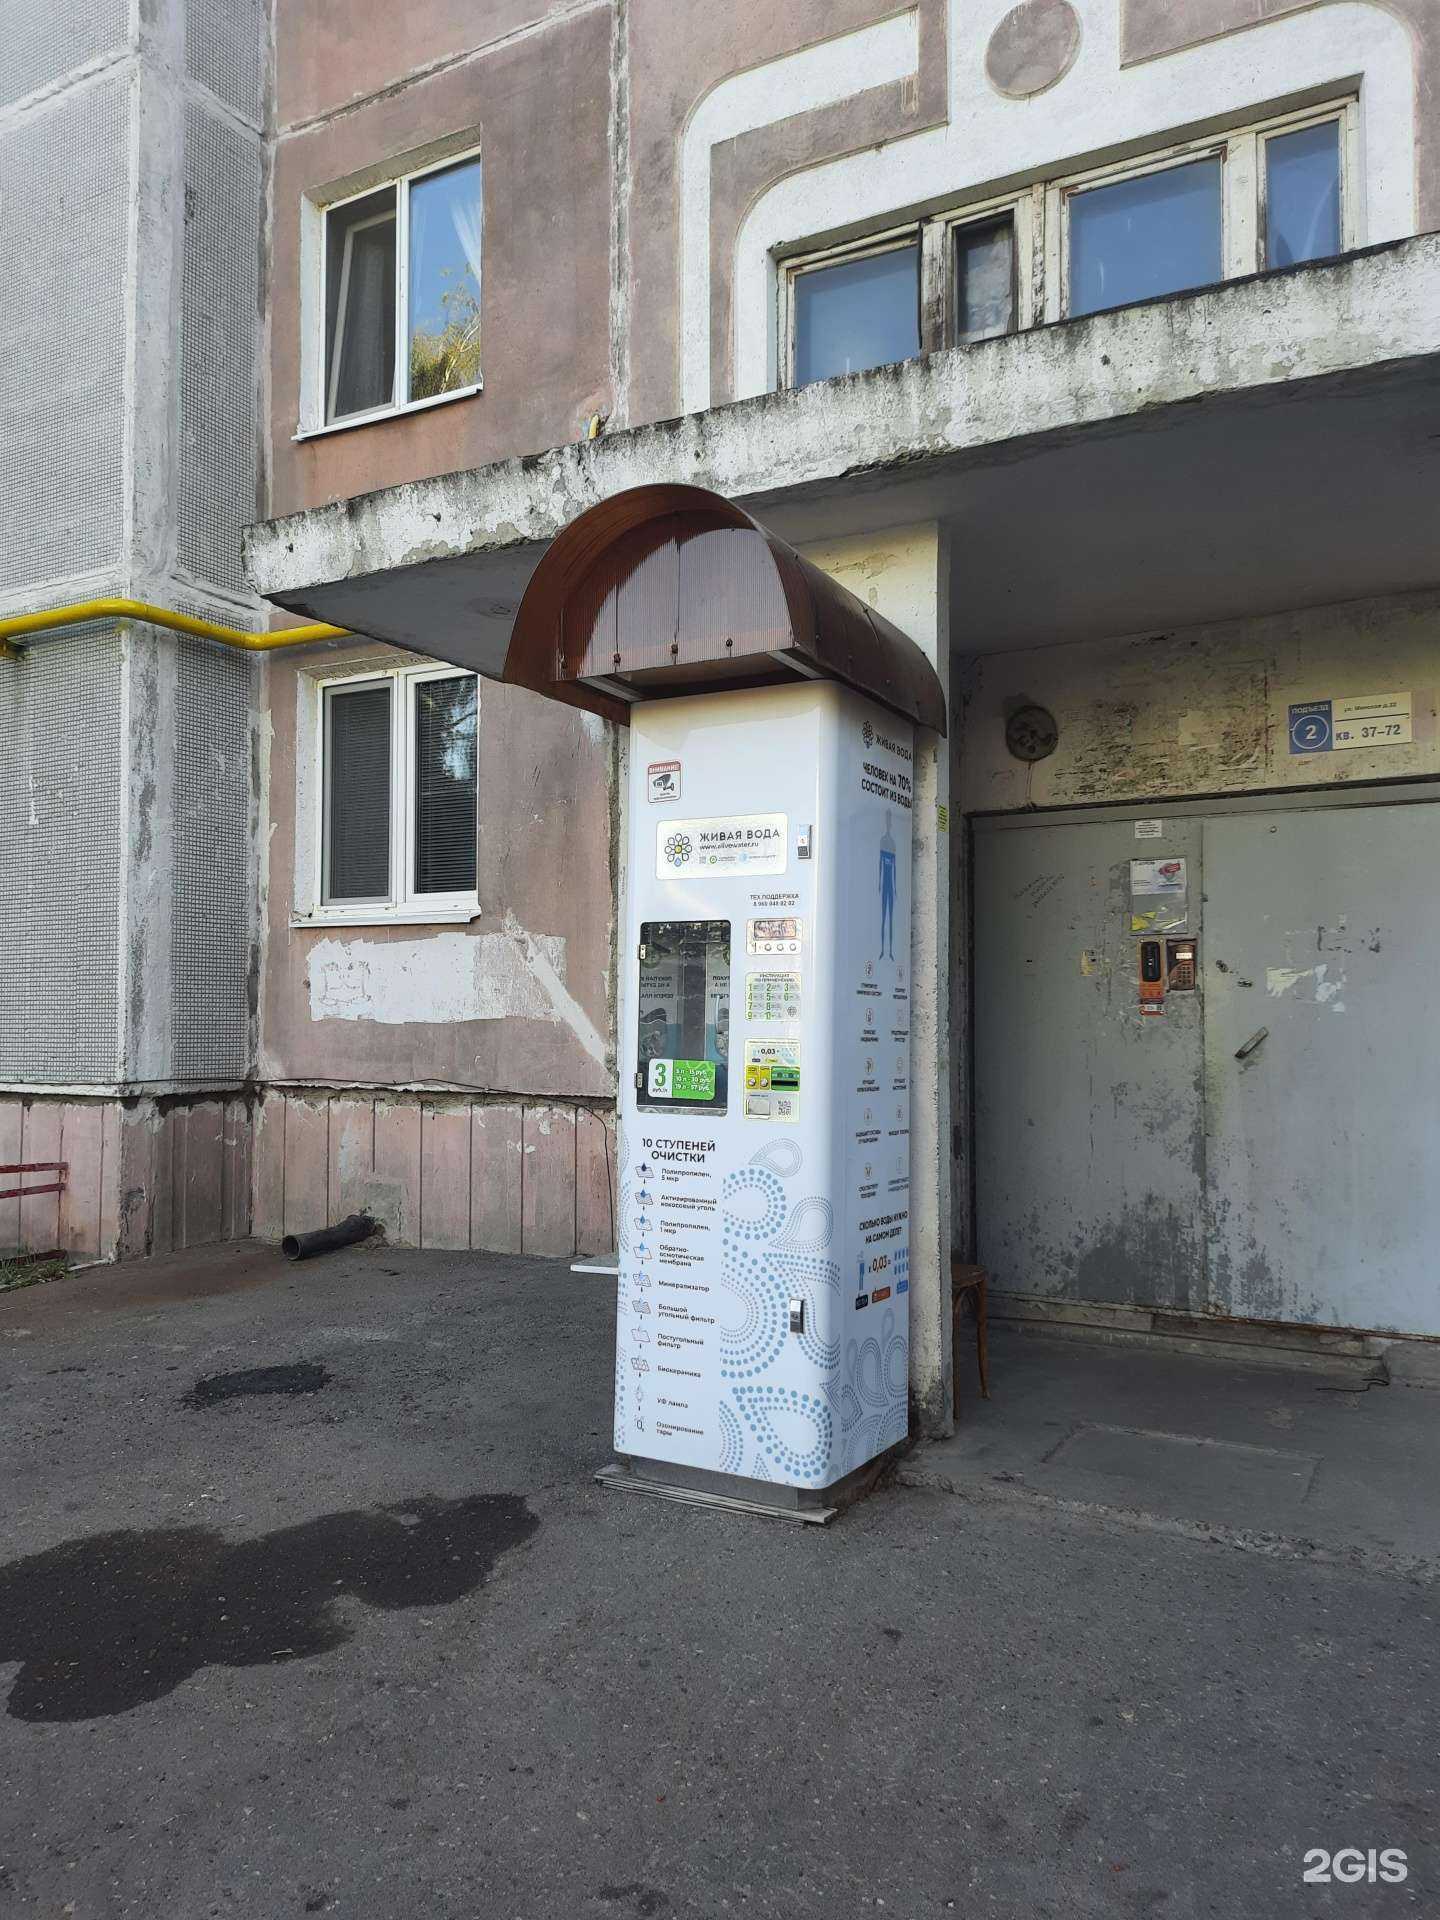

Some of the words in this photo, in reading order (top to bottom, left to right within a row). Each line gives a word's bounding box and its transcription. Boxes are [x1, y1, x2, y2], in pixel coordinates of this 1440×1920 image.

[1305, 724, 1317, 740] 2
[1336, 731, 1354, 741] кв.
[876, 734, 895, 753] ЖИВАЯ
[863, 761, 888, 782] ЧЕЛОВЕК
[889, 774, 896, 786] НА
[898, 774, 911, 793] 70%
[861, 779, 889, 799] СОСТОИТ
[889, 792, 896, 802] ИЗ
[699, 830, 742, 841] ЖИВАЯ
[746, 828, 780, 839] ВОДА
[655, 1063, 666, 1087] 3
[642, 1138, 653, 1148] 10
[655, 1139, 716, 1151] СТУПЕНЕЙ
[651, 1150, 705, 1163] ОЧИСТКИ
[658, 1280, 710, 1292] Минерализатор
[658, 1303, 688, 1312] Большой
